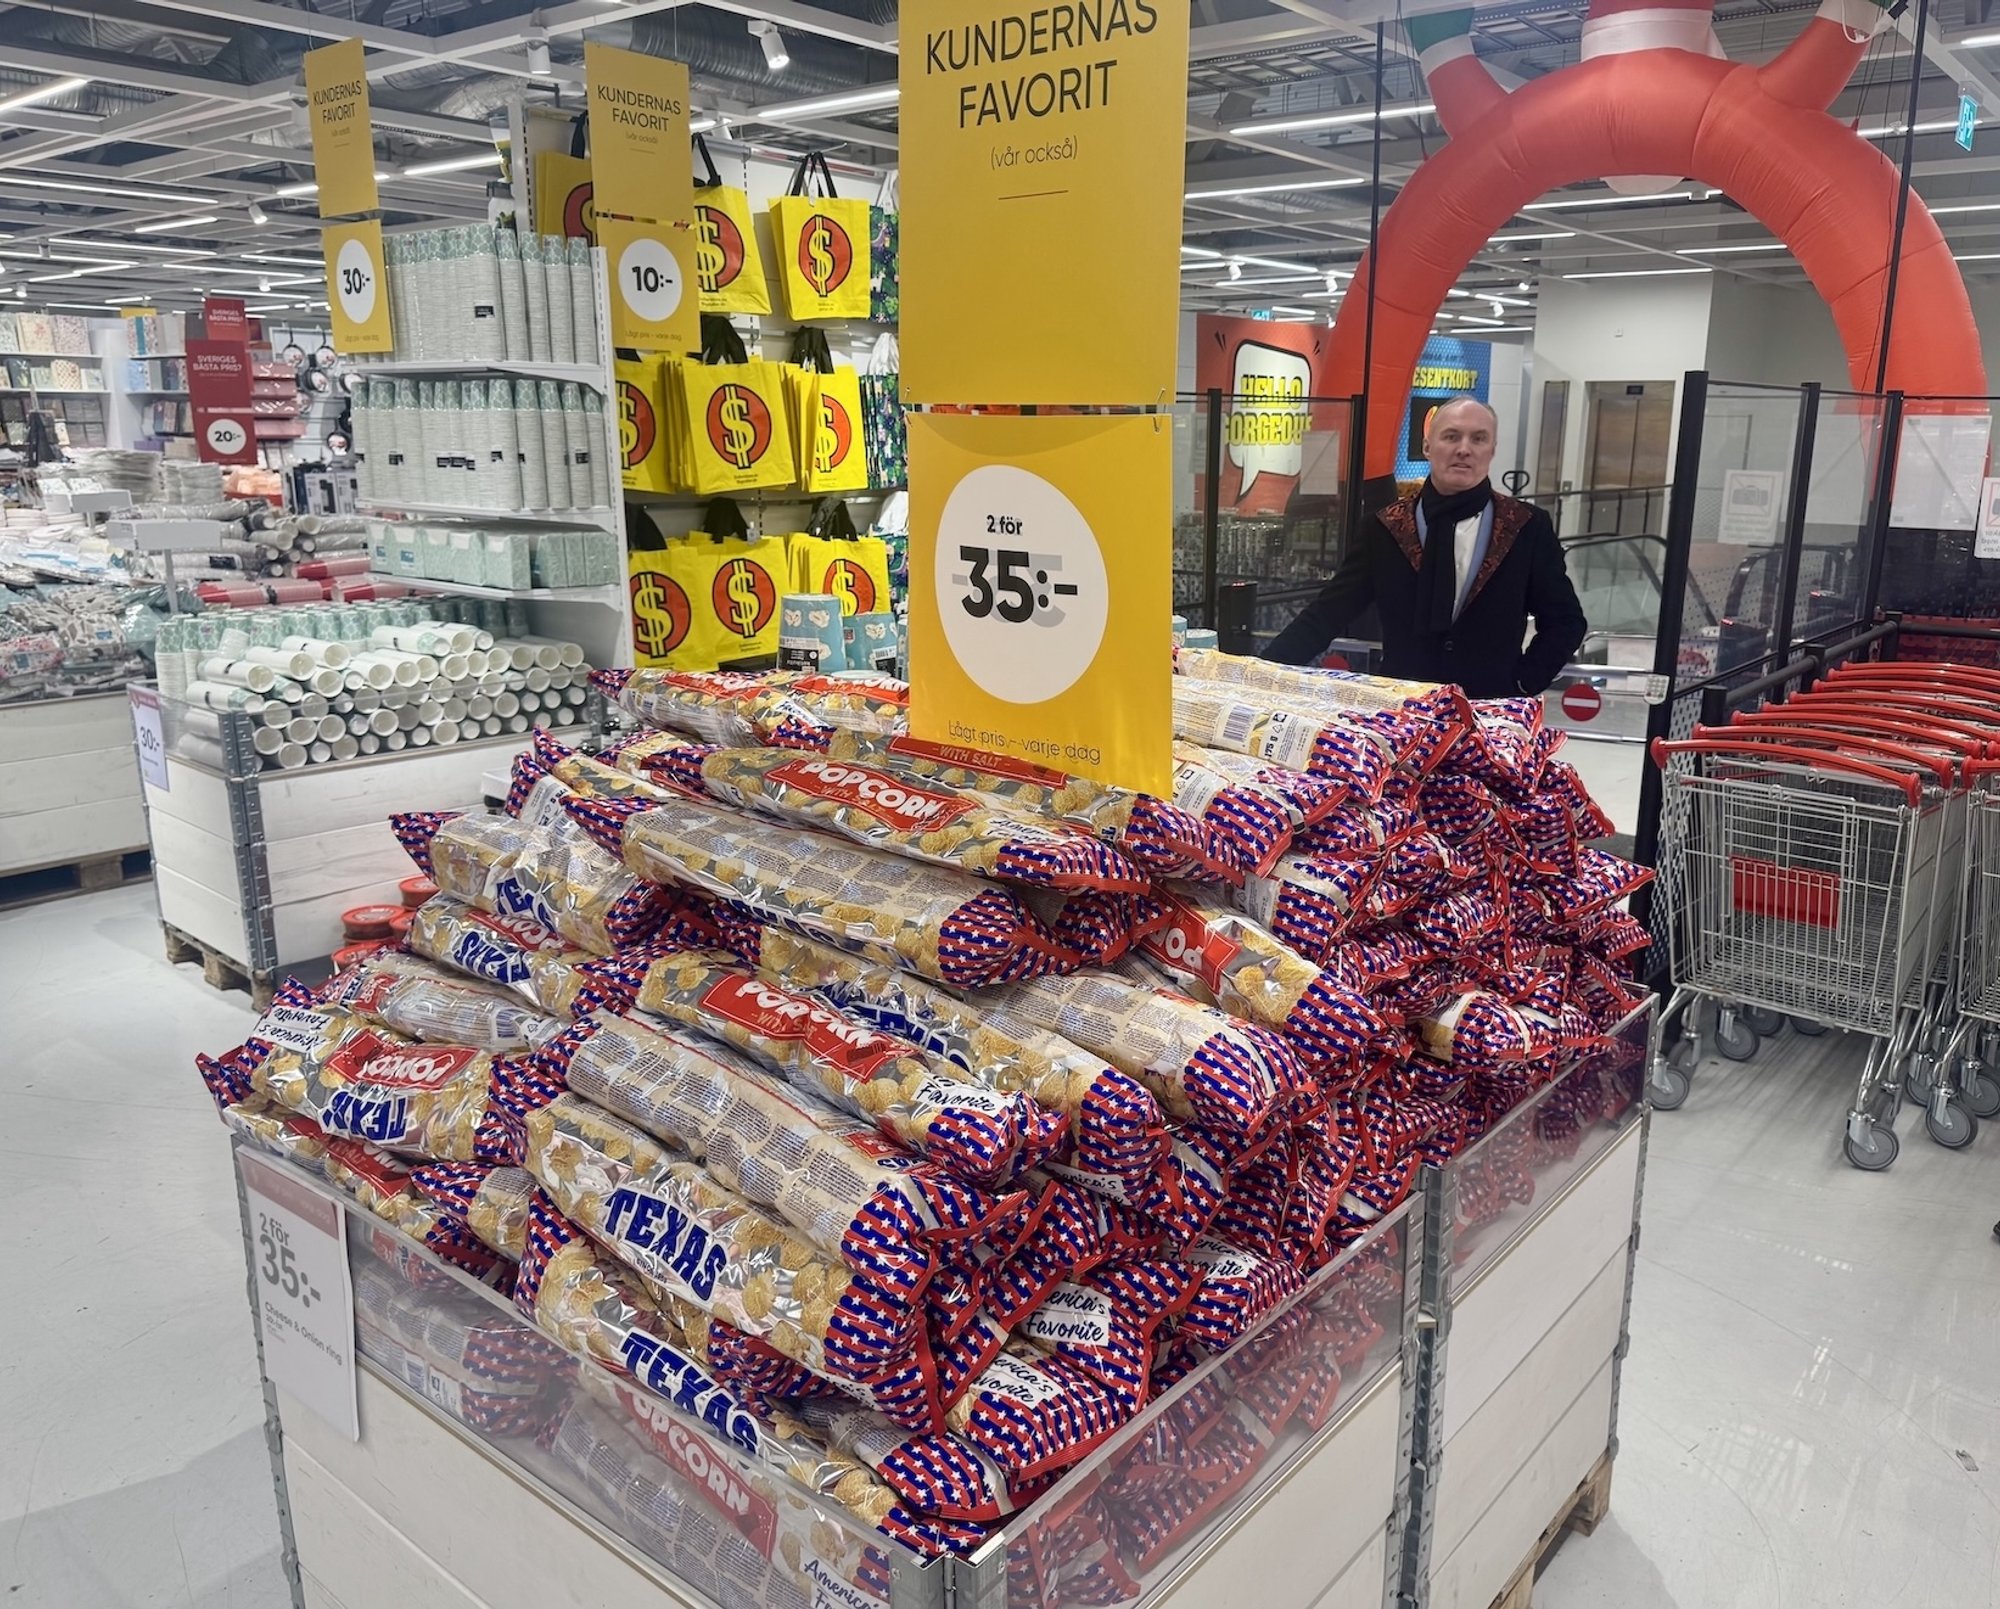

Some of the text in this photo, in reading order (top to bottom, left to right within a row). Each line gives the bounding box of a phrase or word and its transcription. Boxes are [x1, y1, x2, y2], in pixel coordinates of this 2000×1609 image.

[927, 0, 1158, 75] KUNDERNAS
[313, 79, 362, 106] KUNDERNAS
[597, 84, 682, 115] KUNDERNAS
[959, 59, 1118, 128] FAVORIT
[322, 102, 356, 125] FAVORIT
[612, 107, 670, 131] FAVORIT
[990, 135, 1078, 170] (vår också)
[343, 267, 371, 295] 30:-
[631, 266, 673, 293] 10:-
[1241, 374, 1303, 409] HELLO
[986, 514, 1023, 535] 2 för
[959, 545, 1078, 623] 35:-
[140, 726, 160, 752] 30:-
[949, 719, 977, 743] Lågt
[981, 729, 1005, 748] pris
[1021, 738, 1061, 759] varje
[1064, 743, 1101, 765] dag
[972, 752, 1002, 768] SALT
[799, 762, 946, 818] POPCORN
[260, 1212, 290, 1246] 2 för
[604, 1187, 728, 1302] TEXAS
[260, 1233, 321, 1309] 35:-
[265, 1301, 293, 1328] Cheese
[300, 1326, 325, 1352] Onion
[326, 1345, 342, 1366] ring
[1026, 1311, 1105, 1342] Favorite
[620, 1331, 760, 1455] TEXAS
[632, 1394, 750, 1516] OPCORN
